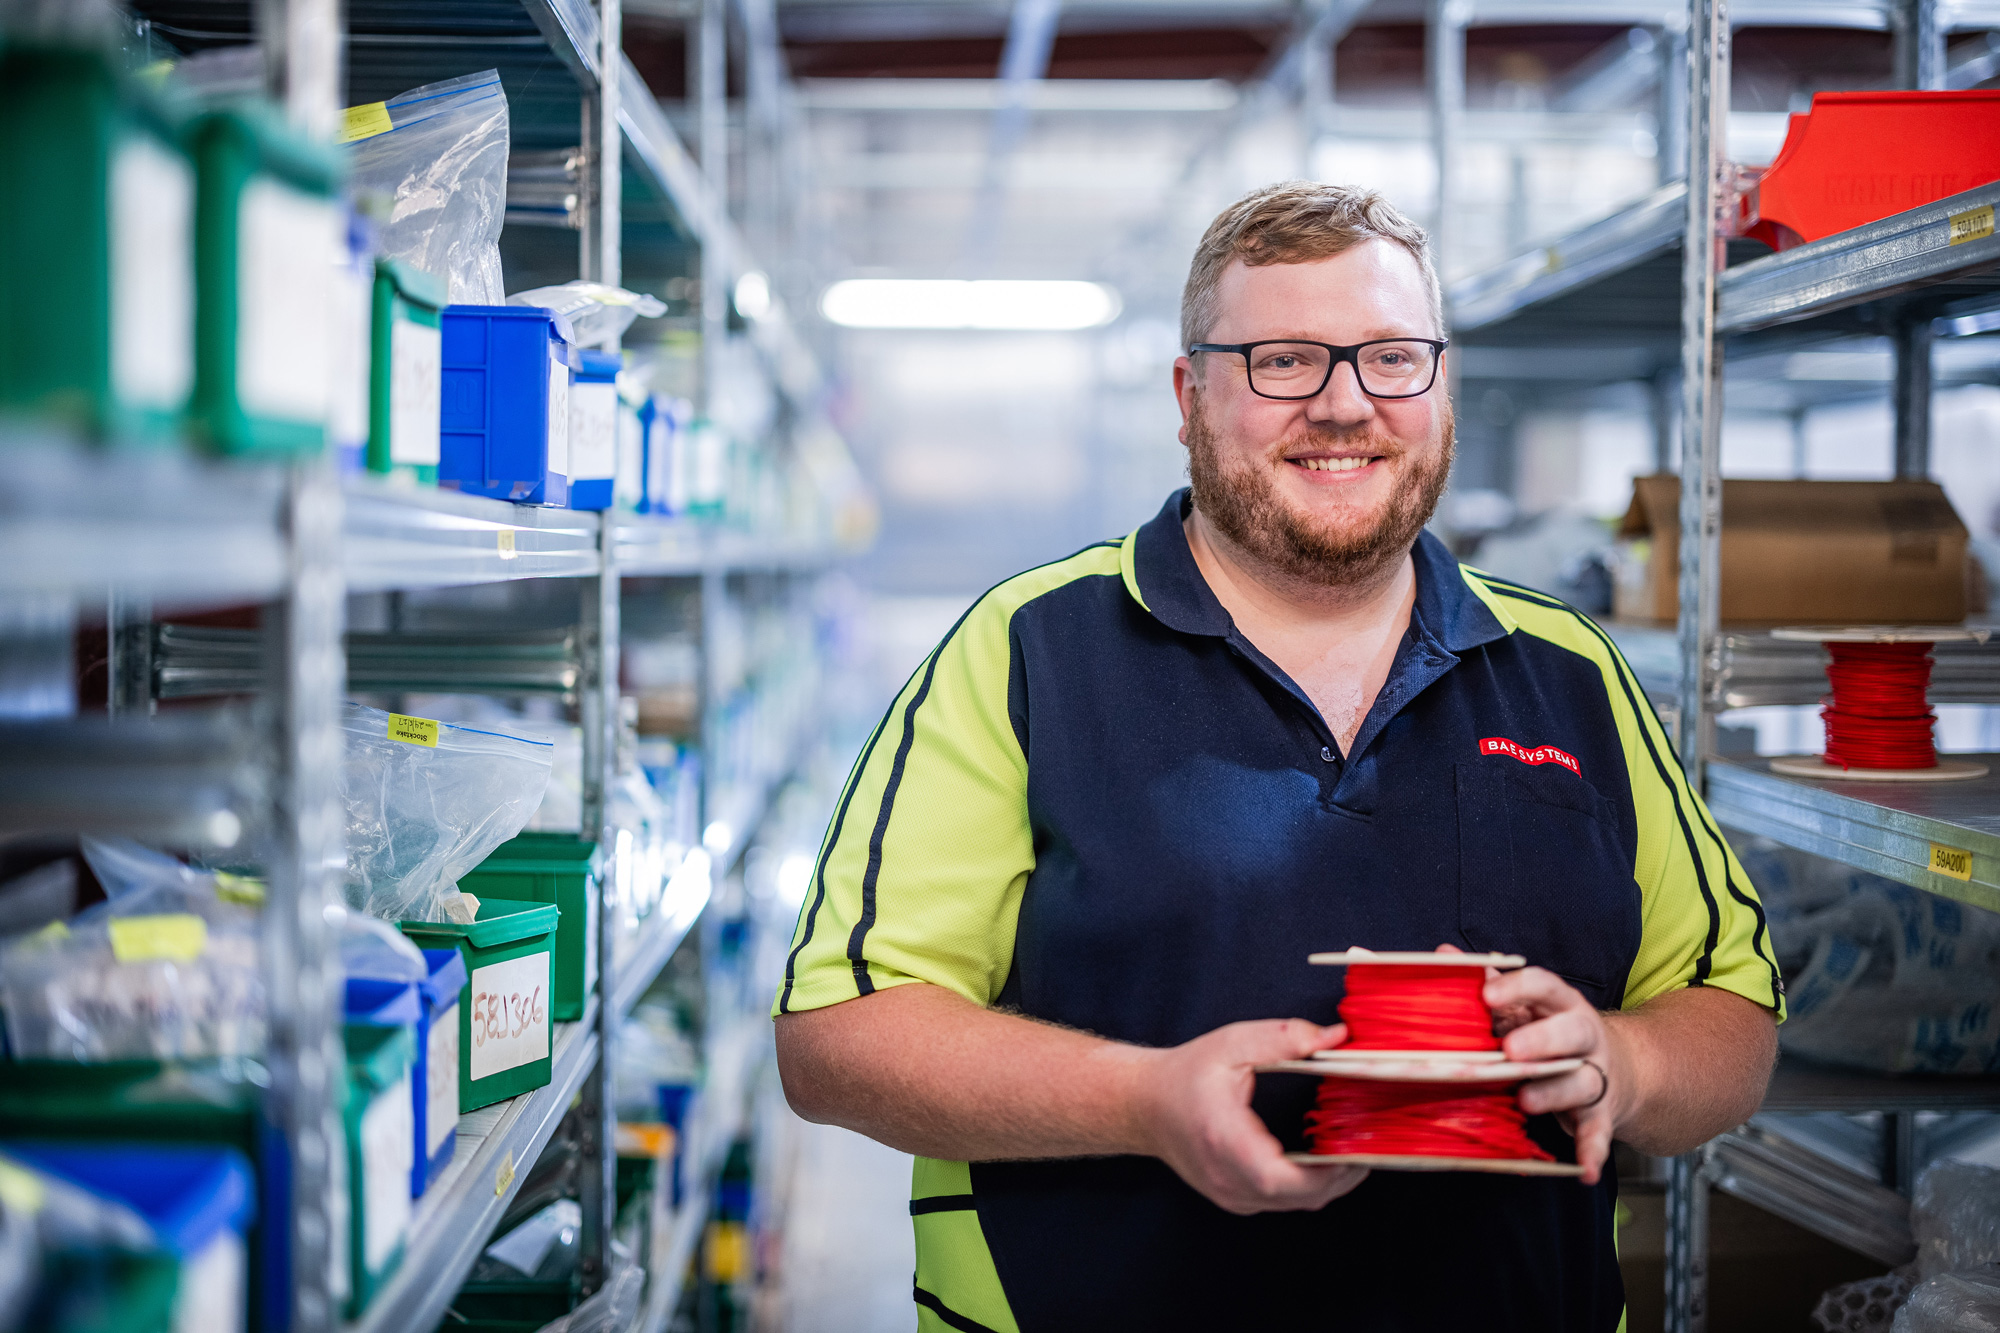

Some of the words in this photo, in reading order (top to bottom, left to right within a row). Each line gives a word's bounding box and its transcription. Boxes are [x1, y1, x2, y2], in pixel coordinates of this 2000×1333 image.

[1957, 214, 1987, 239] 59A100
[396, 730, 427, 741] Stocktake
[1488, 741, 1517, 755] BAE
[1518, 748, 1577, 770] SYSTEMS
[1936, 850, 1965, 873] 59A200
[474, 985, 543, 1047] 58J306
